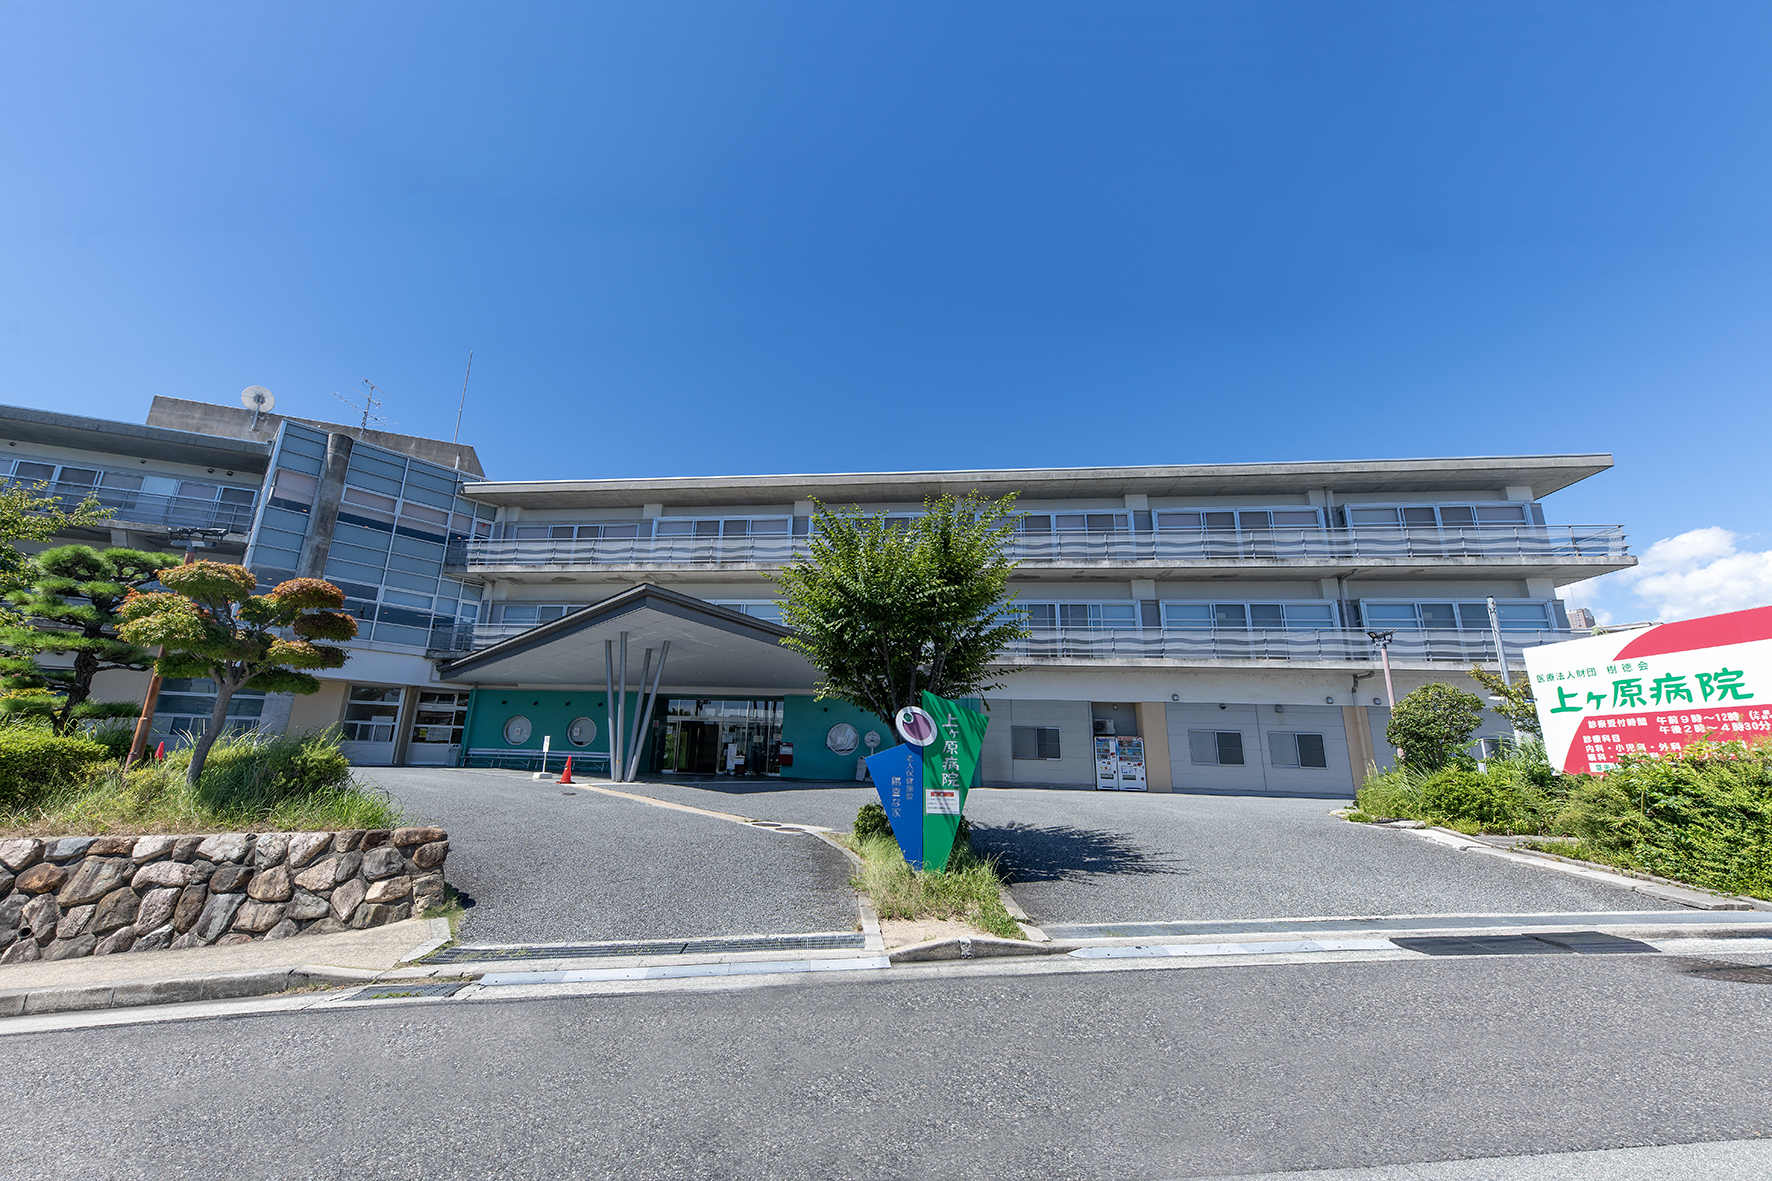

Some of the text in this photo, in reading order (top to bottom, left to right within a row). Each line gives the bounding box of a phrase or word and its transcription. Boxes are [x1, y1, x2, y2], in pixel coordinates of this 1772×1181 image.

[1536, 667, 1597, 683] 医療法人財団
[1550, 668, 1755, 714] 上ヶ原病院
[942, 713, 960, 787] 上ヶ原病院
[1583, 734, 1621, 743] 診療科目
